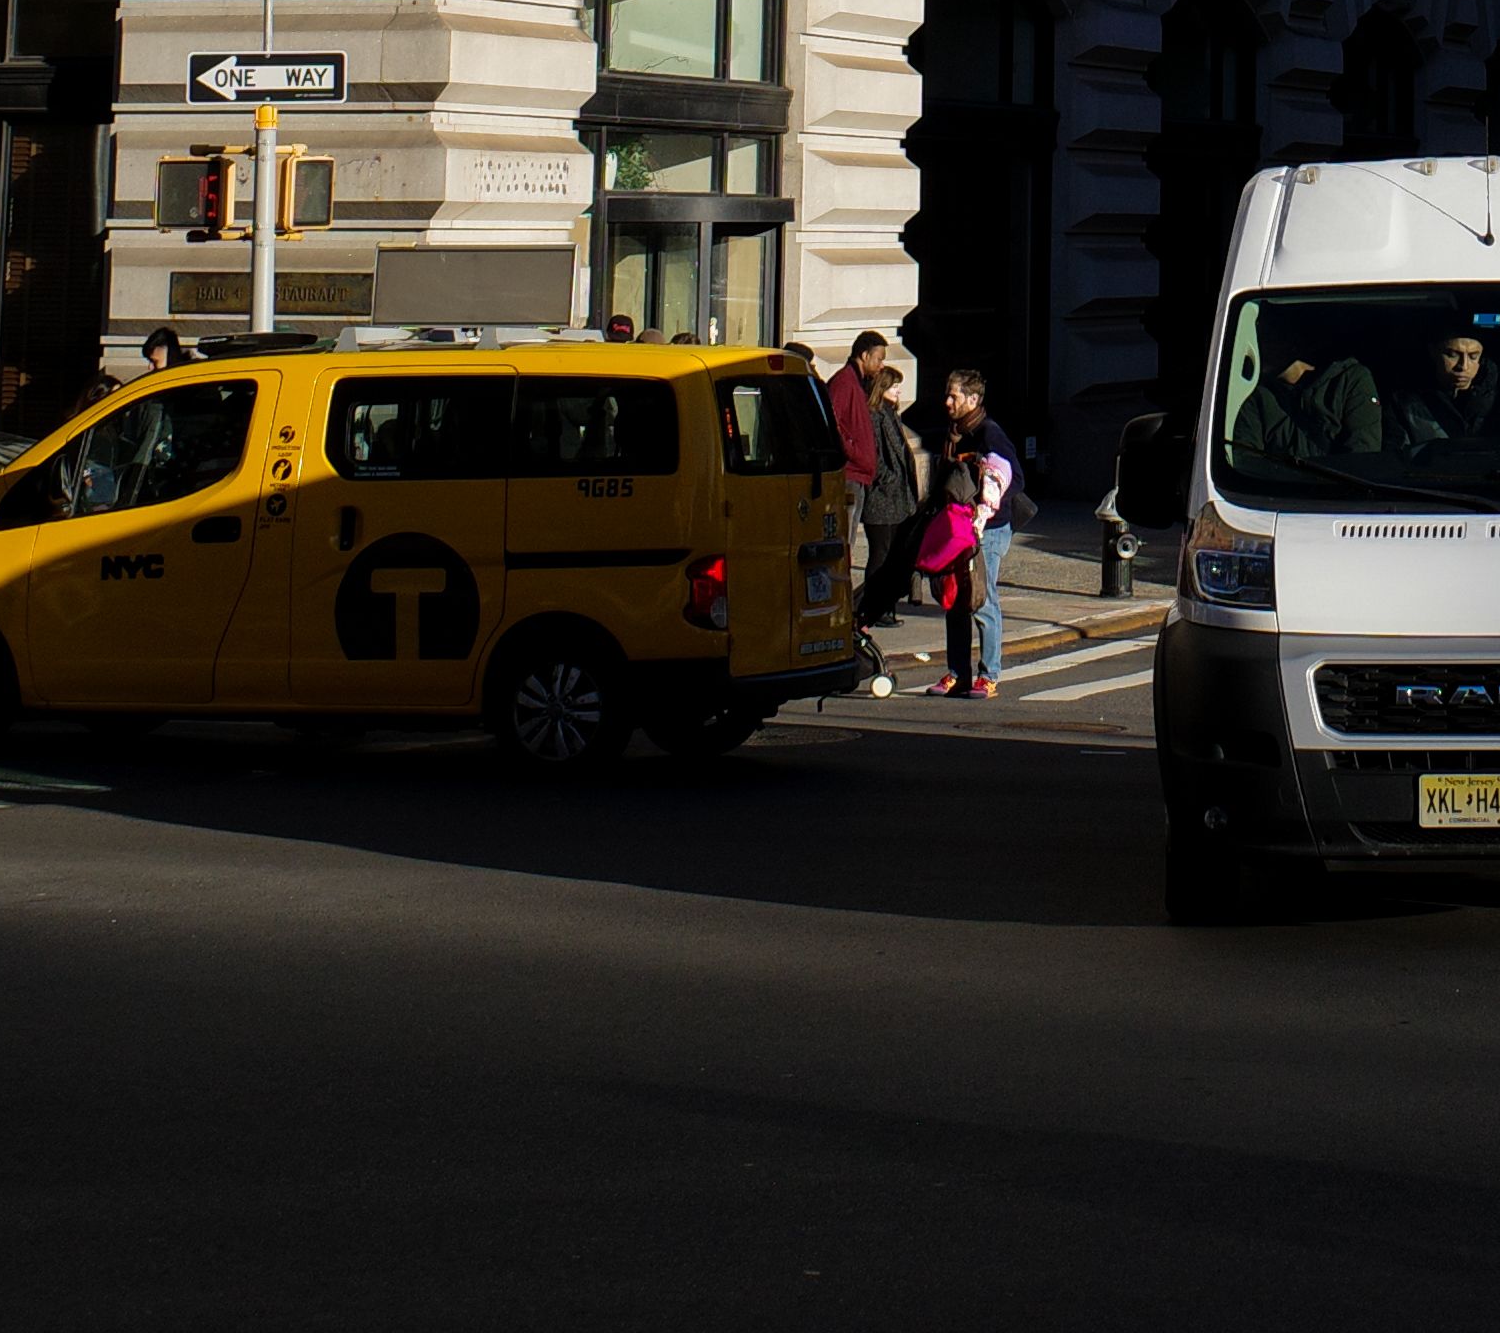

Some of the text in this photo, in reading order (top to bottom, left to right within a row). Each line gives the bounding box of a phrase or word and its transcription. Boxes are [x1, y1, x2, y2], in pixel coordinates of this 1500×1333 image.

[214, 68, 328, 87] ONE WAY
[196, 286, 228, 302] BAR
[275, 286, 349, 303] STAURANT
[577, 478, 634, 498] 9G85
[101, 553, 165, 581] NYC
[1445, 777, 1495, 787] New Jersey
[1426, 788, 1463, 814] XKL
